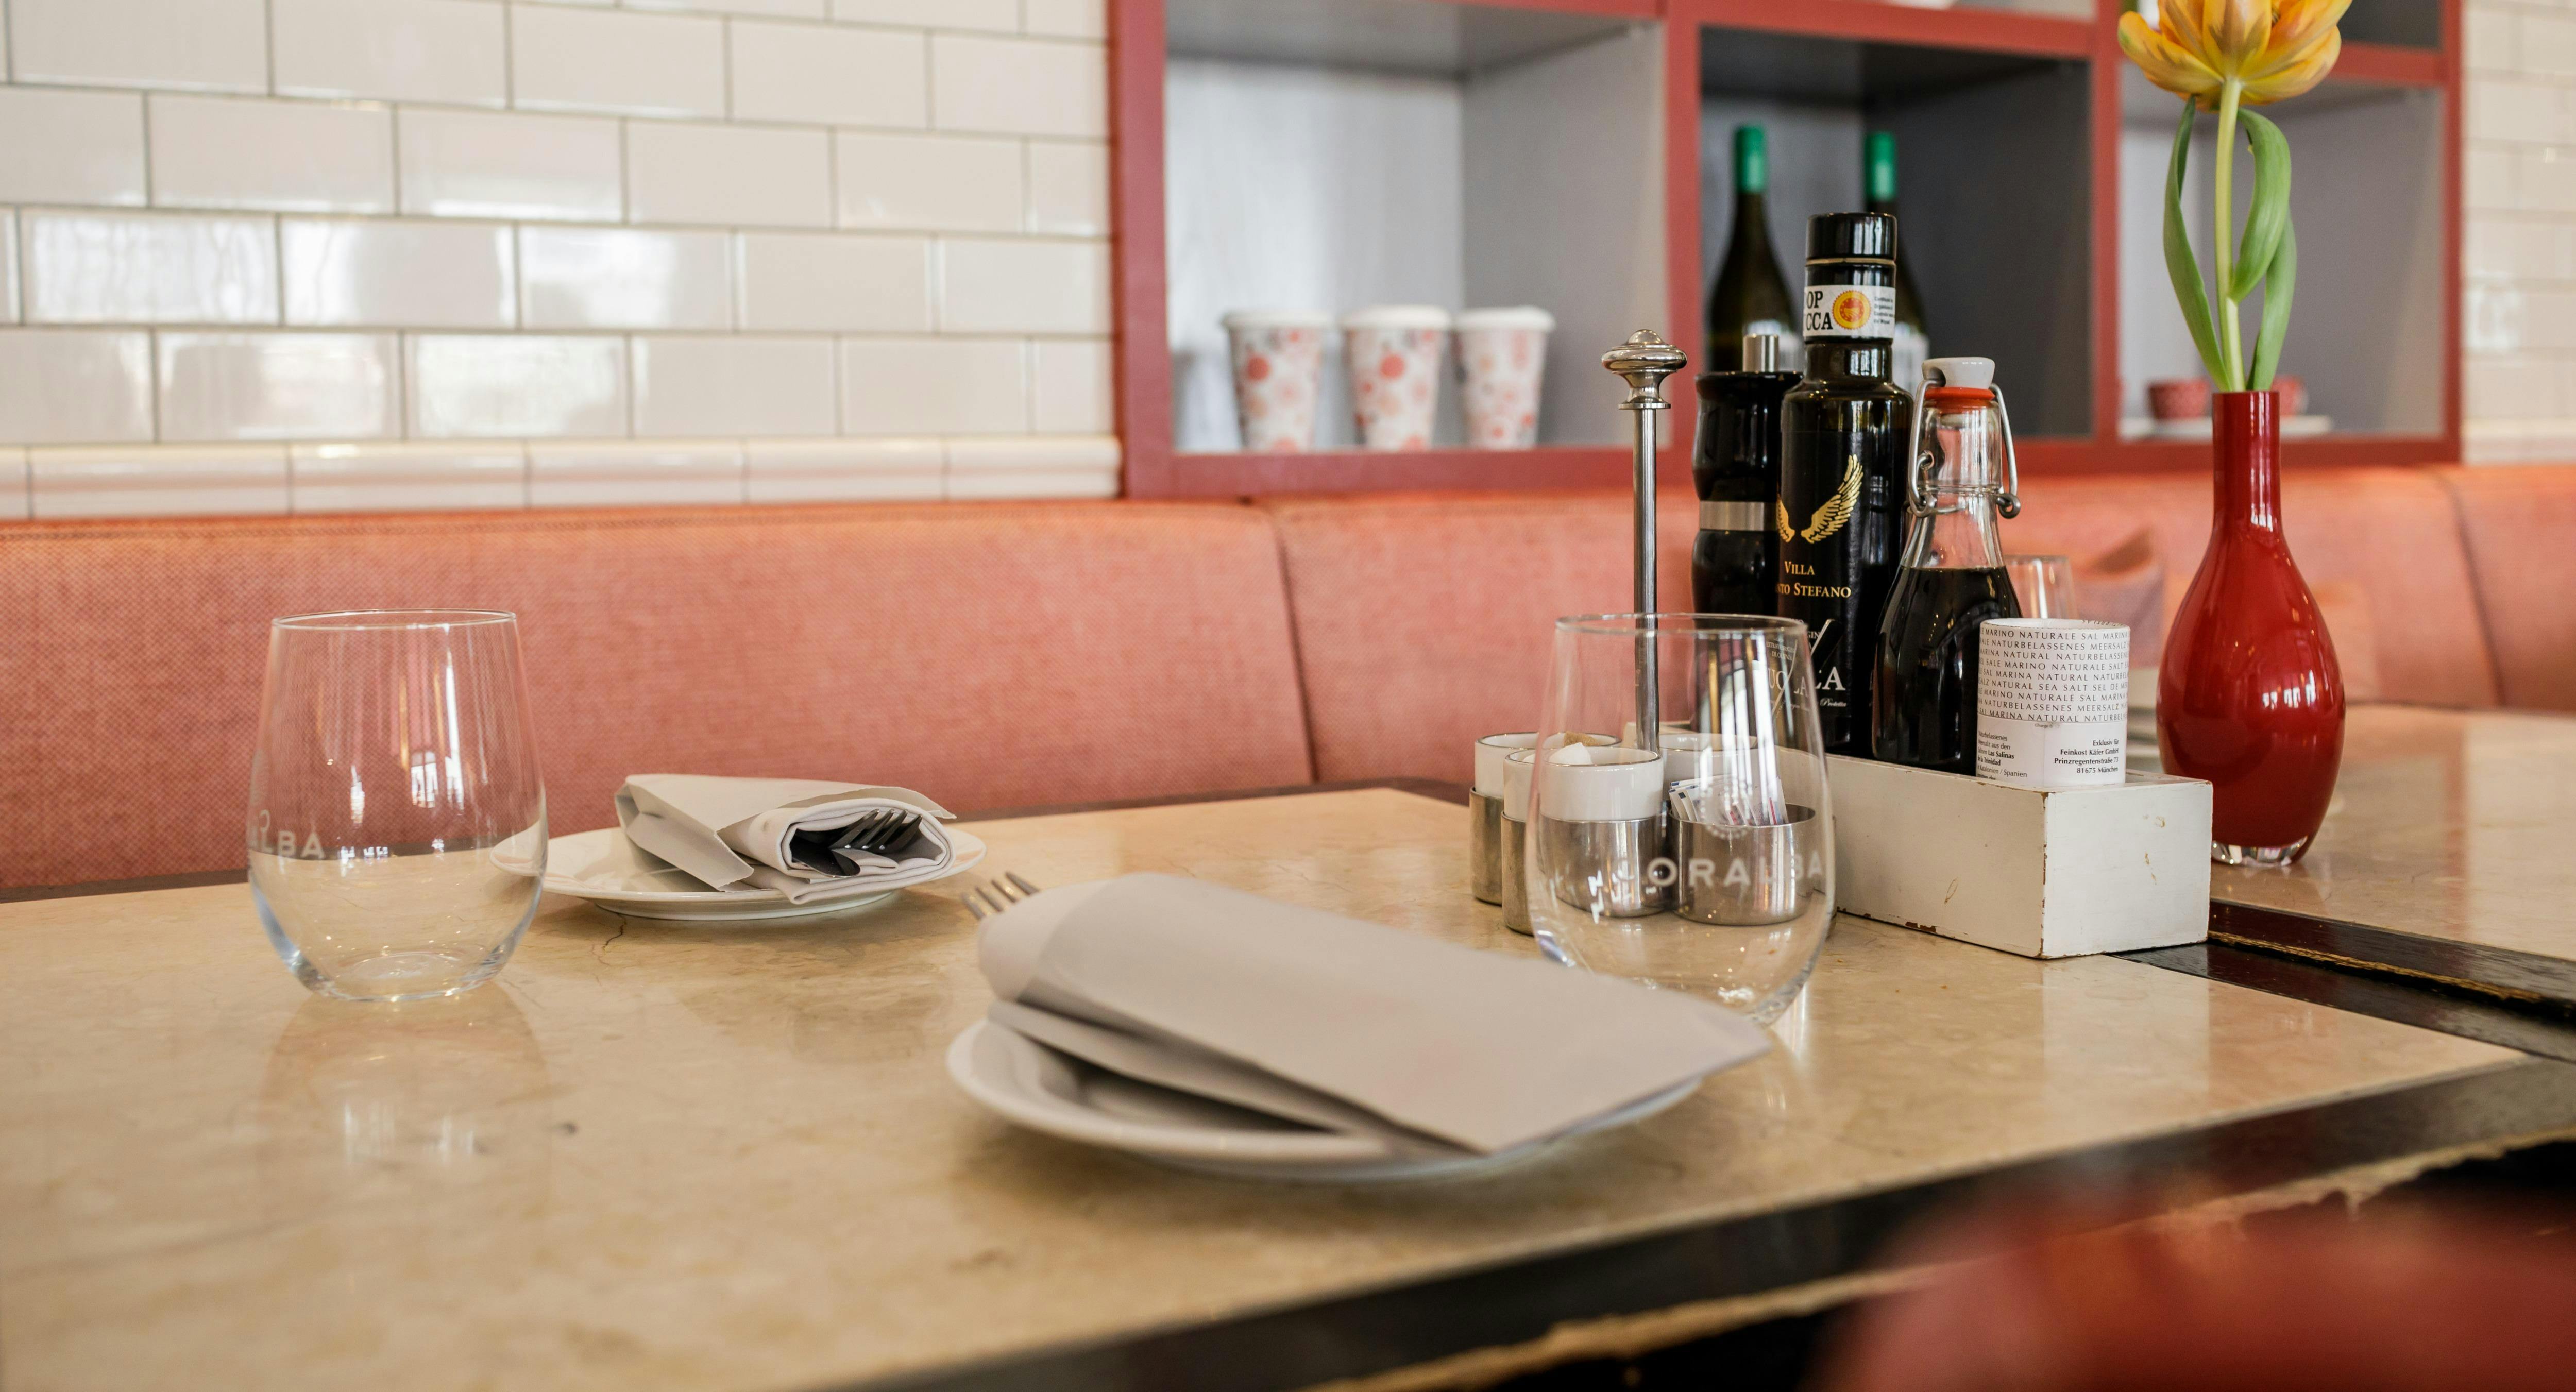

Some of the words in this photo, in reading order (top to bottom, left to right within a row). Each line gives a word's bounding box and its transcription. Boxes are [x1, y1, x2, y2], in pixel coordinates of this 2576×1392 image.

[1784, 561, 1815, 576] VILLA
[1794, 582, 1852, 598] STEFANO
[1986, 629, 2014, 638] MARINO
[2020, 631, 2076, 640] NATURALE
[1992, 639, 2085, 650] NATURBELASSENES
[2090, 641, 2126, 650] MEERSALZ
[2004, 651, 2049, 660] NATURAL
[1986, 659, 2001, 667] SALE
[2005, 660, 2045, 670] MARINO
[1996, 670, 2031, 680] MARINA
[2038, 673, 2088, 681] NATURAL
[1992, 680, 2033, 690] NATURAL
[2110, 683, 2118, 691] DE
[1984, 689, 2013, 699] MARINO
[2018, 692, 2074, 702] NATURALE
[2101, 692, 2125, 701] MARINA
[1985, 699, 2072, 712] NATURBELASSENES
[2077, 703, 2119, 712] MEERSALZ
[1990, 710, 2023, 720] MARINA
[2028, 714, 2078, 722] NATURAL
[1996, 751, 2014, 759] Salinas
[1984, 757, 2001, 766] Trinidad
[2054, 757, 2113, 767] Prinzregentenstraße
[2004, 769, 2027, 777] Spanien
